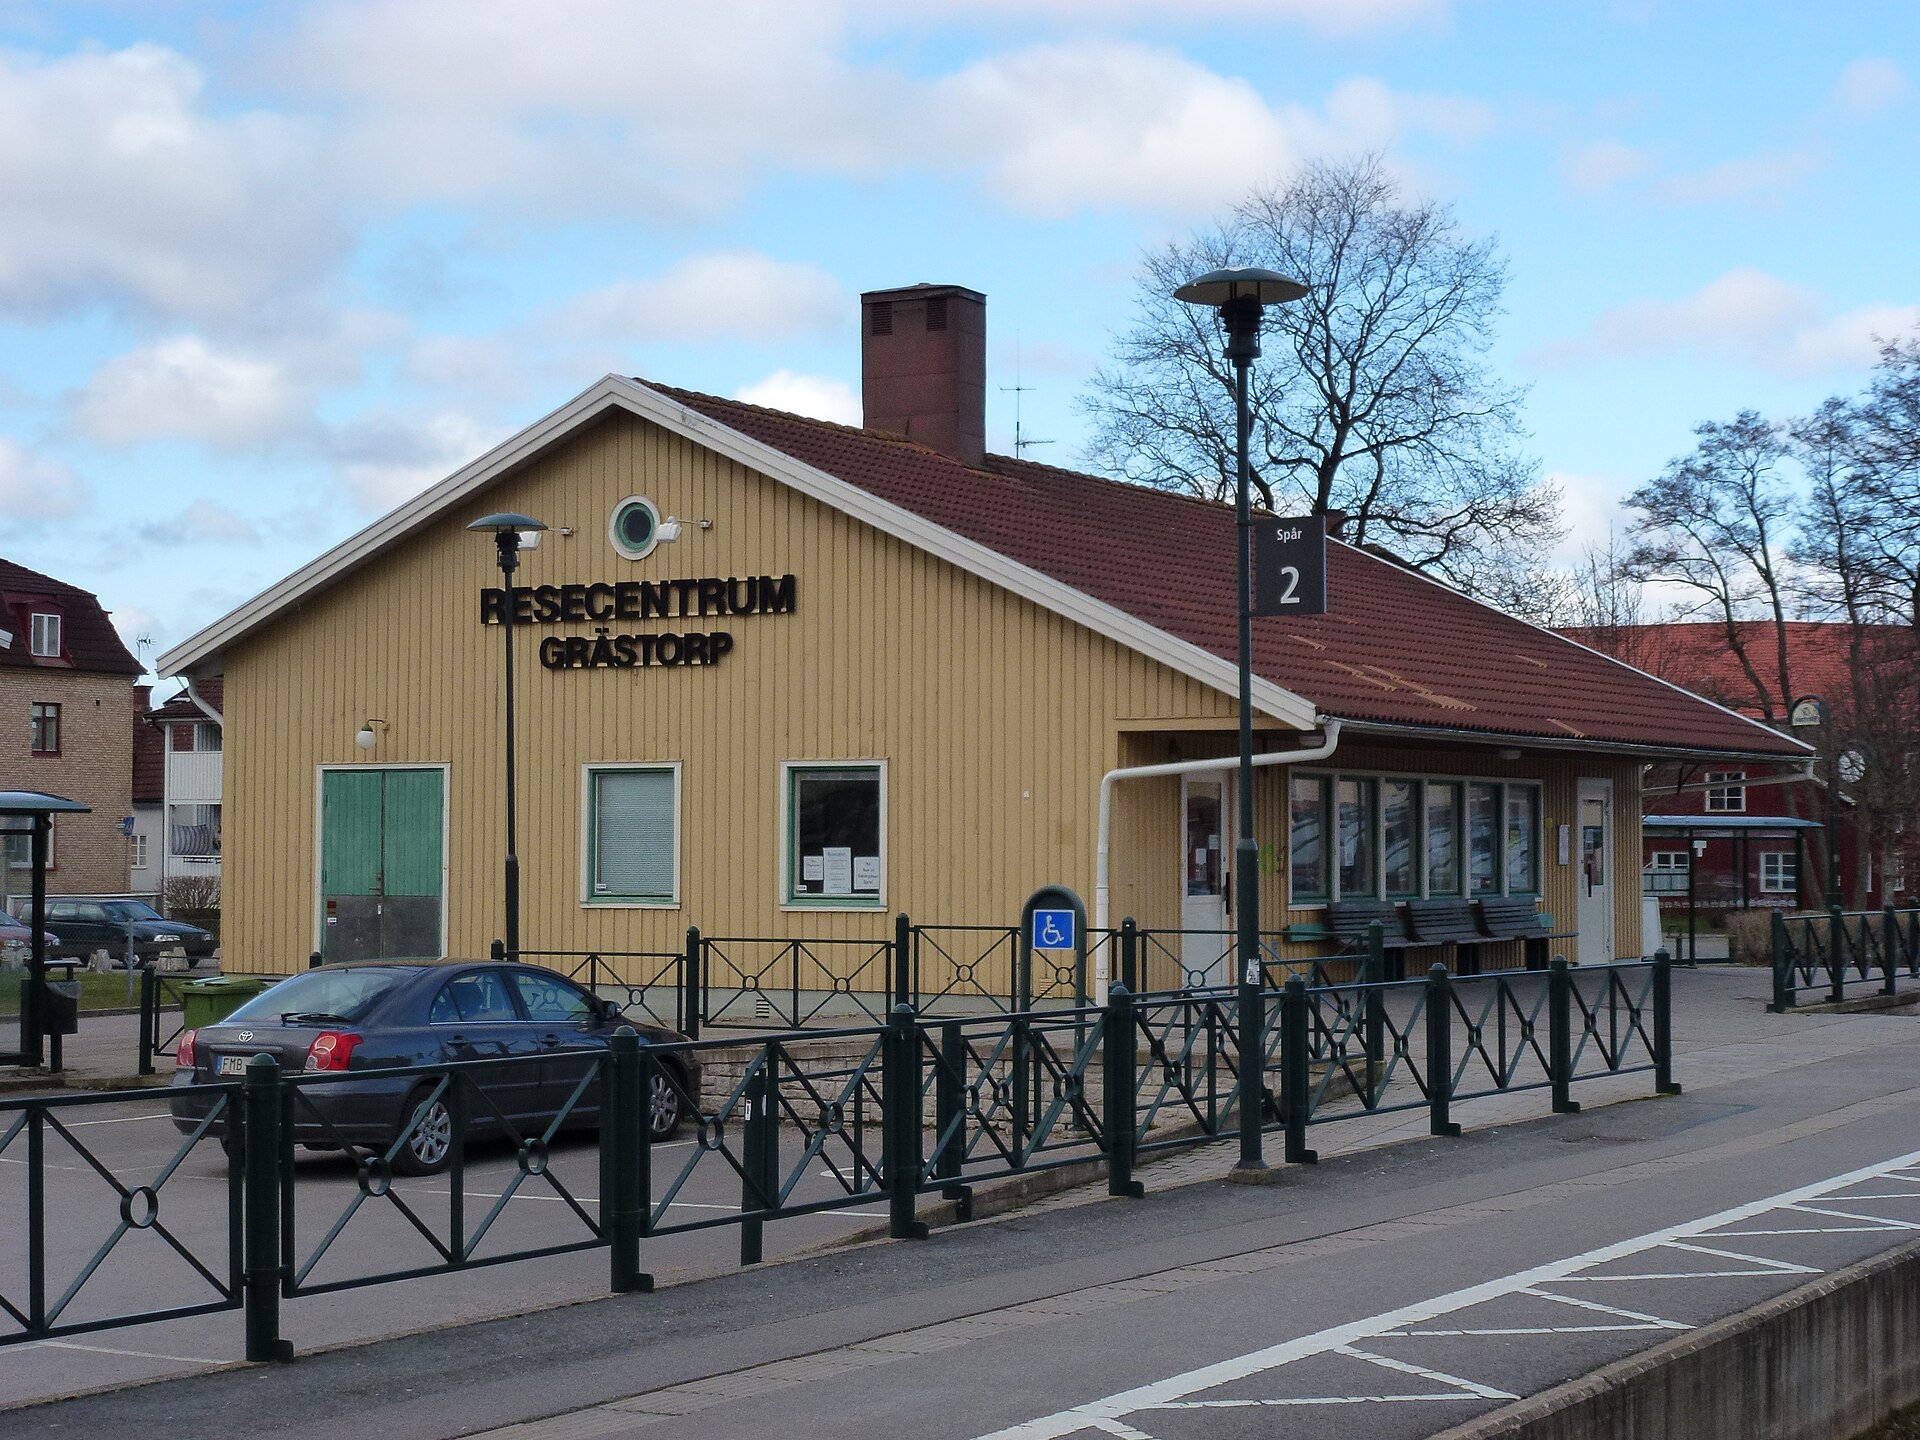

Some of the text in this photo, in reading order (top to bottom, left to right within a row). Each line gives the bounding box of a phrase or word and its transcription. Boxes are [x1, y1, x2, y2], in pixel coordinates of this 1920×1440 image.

[1277, 527, 1303, 543] Spår
[480, 574, 797, 625] RESECENTRUM
[1280, 566, 1300, 604] 2
[539, 627, 734, 669] GRÄSTORP
[222, 1057, 243, 1071] FMB
